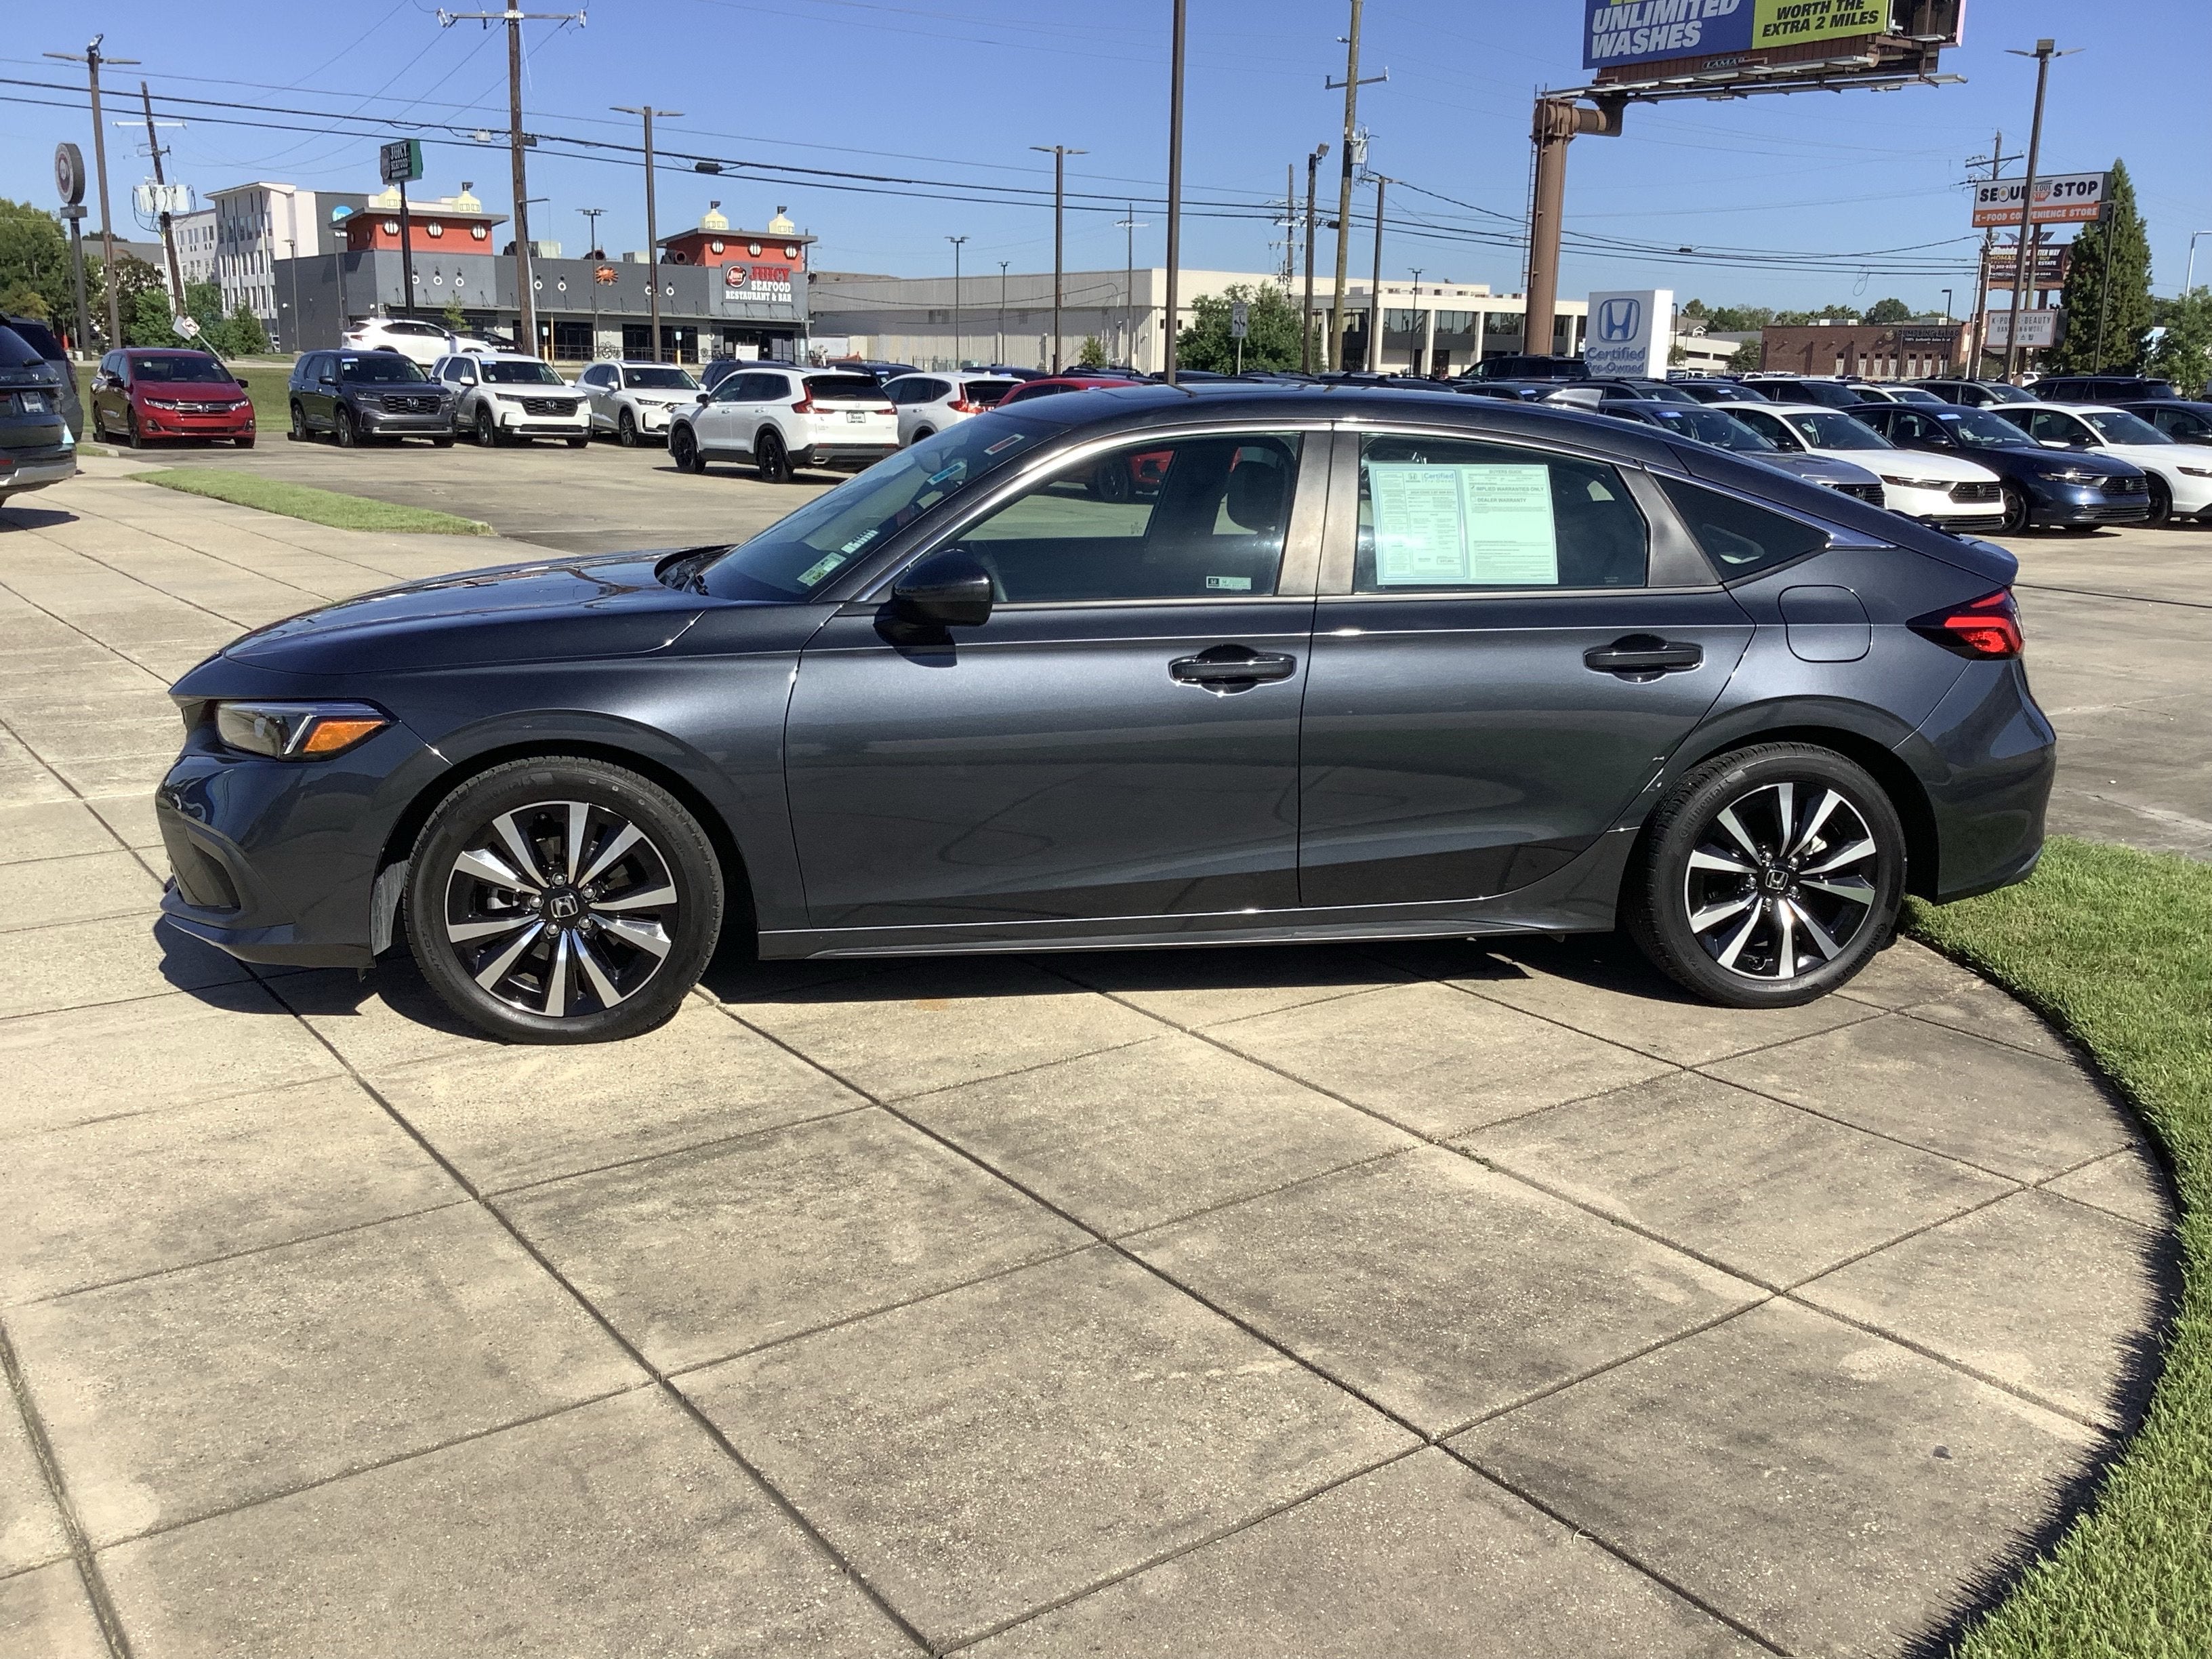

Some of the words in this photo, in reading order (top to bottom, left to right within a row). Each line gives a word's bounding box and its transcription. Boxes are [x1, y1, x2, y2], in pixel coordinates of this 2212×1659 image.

[1593, 0, 1740, 33] UNLIMITED
[1777, 1, 1831, 20] WORTH
[1836, 0, 1865, 12] THE
[1762, 18, 1810, 37] EXTRA
[1815, 16, 1826, 30] 2
[1830, 10, 1879, 28] MILES
[1592, 20, 1702, 59] WASHES
[390, 142, 407, 161] JUICY
[1980, 184, 2026, 203] SEOU
[2053, 180, 2098, 197] STOP
[1975, 212, 2007, 222] K-FOOD
[2069, 207, 2098, 217] STORE
[749, 266, 791, 281] JUICY
[751, 281, 791, 292] SEAFOOD
[725, 291, 770, 301] RESTAURANT
[771, 293, 777, 302] &
[778, 293, 792, 302] BAR
[1586, 346, 1646, 361] Certified
[1586, 362, 1645, 373] Pre-Owned
